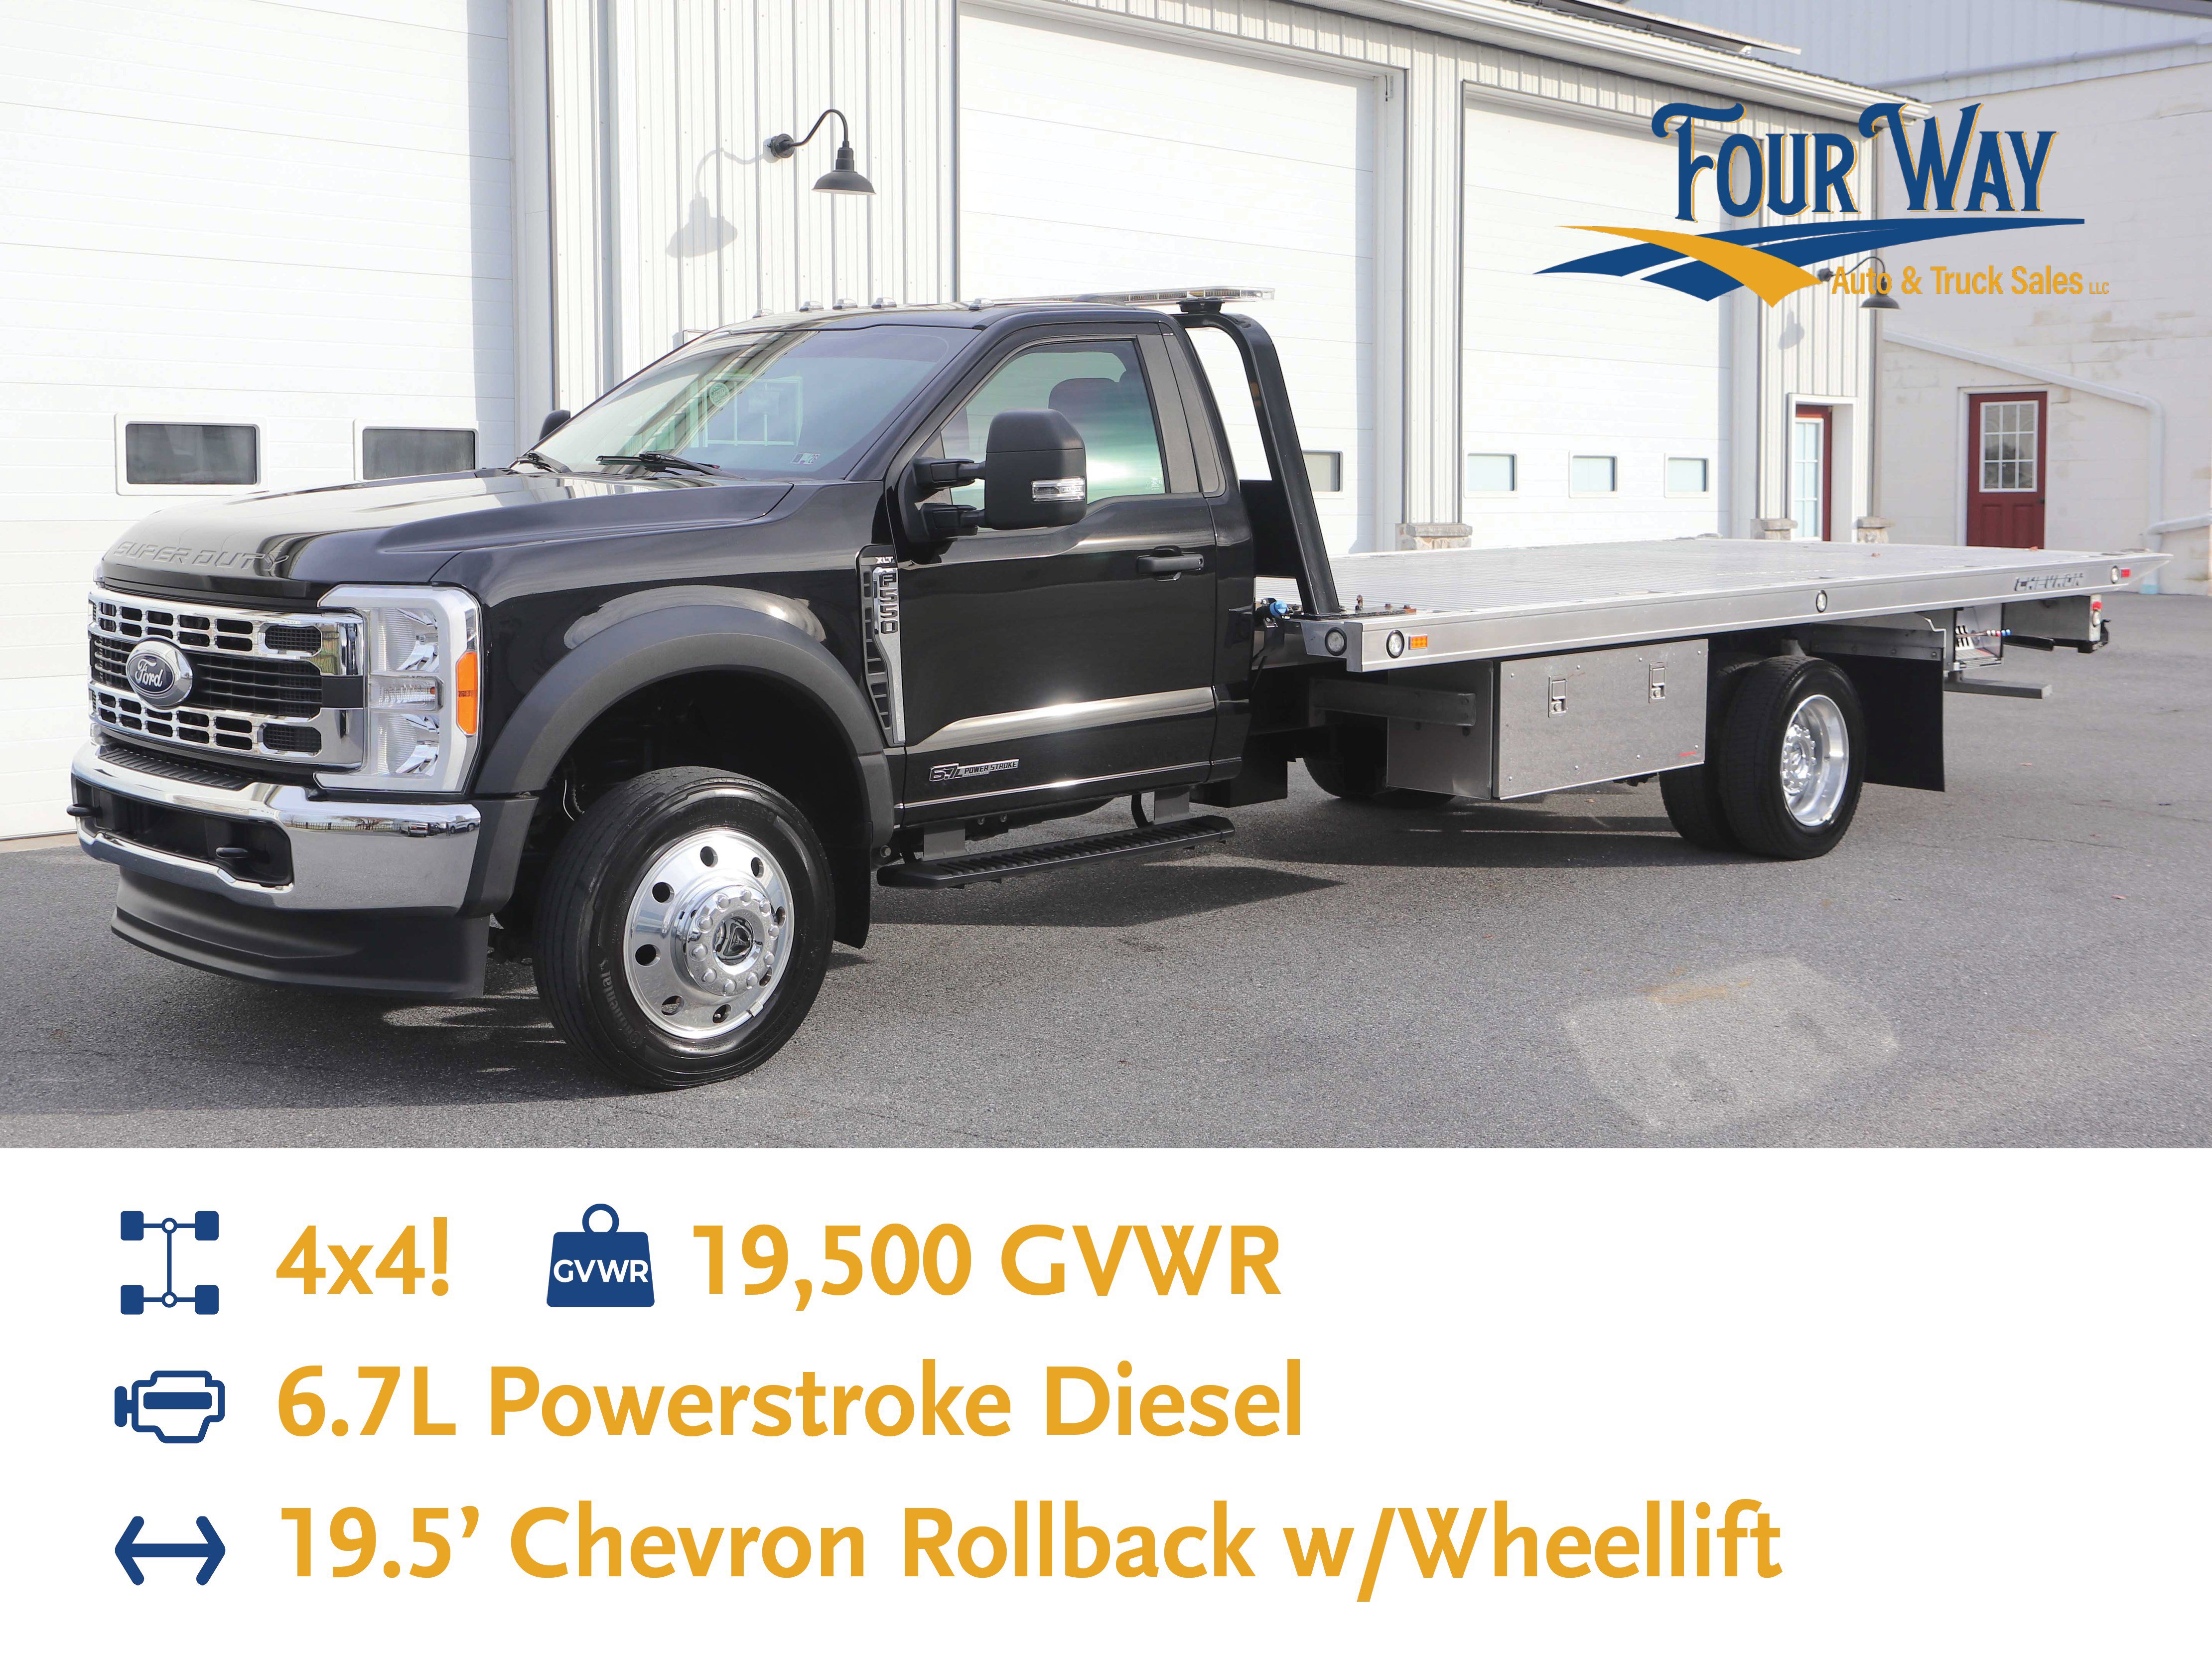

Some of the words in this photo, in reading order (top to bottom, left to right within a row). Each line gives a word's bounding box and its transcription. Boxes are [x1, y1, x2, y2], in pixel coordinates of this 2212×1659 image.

[114, 541, 192, 564] SUPER
[192, 550, 289, 571] DUTY
[135, 659, 163, 688] Ford
[964, 765, 989, 774] POWER
[989, 761, 1018, 771] STROKE
